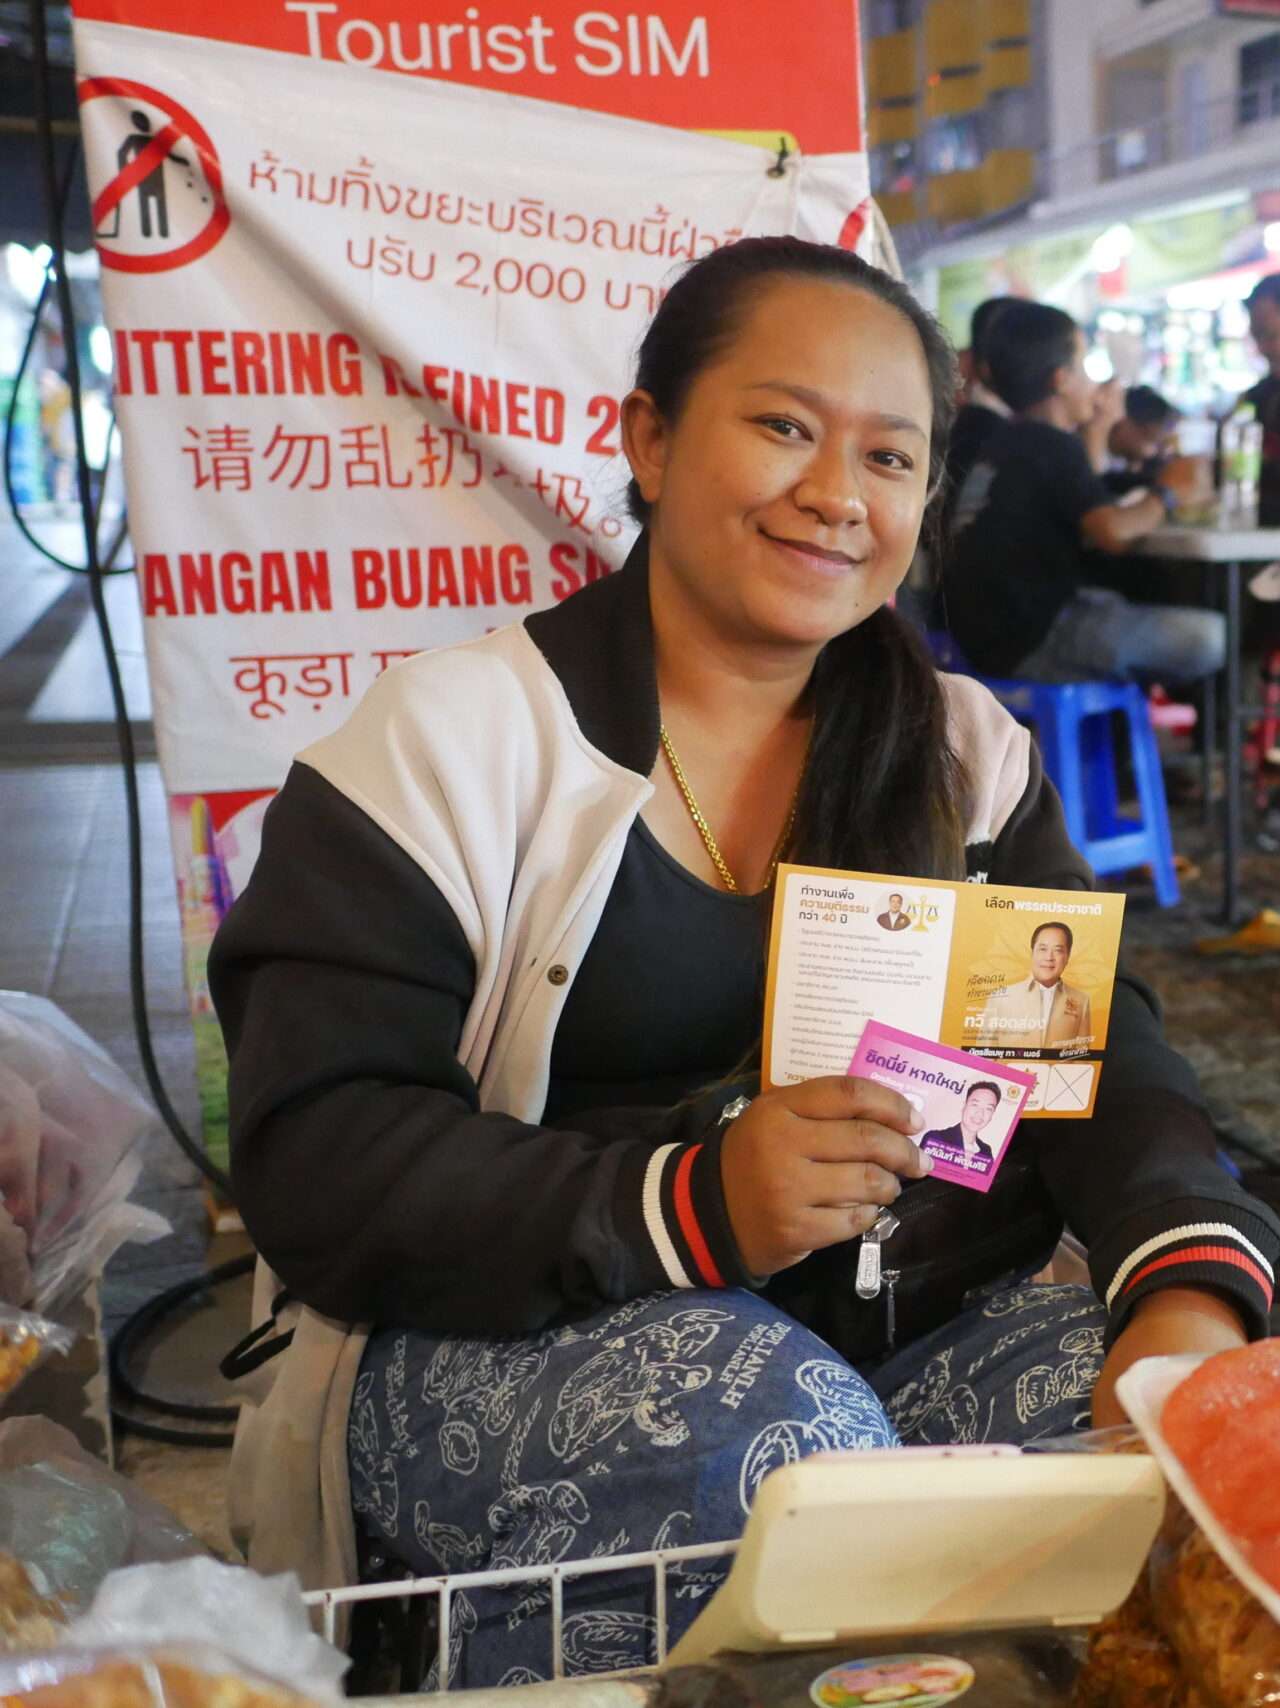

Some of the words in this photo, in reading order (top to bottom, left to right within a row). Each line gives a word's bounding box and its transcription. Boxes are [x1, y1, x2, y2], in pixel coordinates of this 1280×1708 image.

[287, 1, 555, 75] Tourist
[574, 12, 709, 77] SIM
[249, 150, 742, 262] ห้ามทิ้งขยะบริเวณนี้ฝ่า
[346, 235, 435, 279] ปรับ
[455, 253, 586, 305] 2,000
[604, 279, 669, 315] บา
[113, 329, 363, 397] ITTERING
[182, 424, 622, 538] 请勿乱扔圾。
[354, 542, 532, 611] BUANG
[909, 1067, 966, 1095] หาดใหญ่
